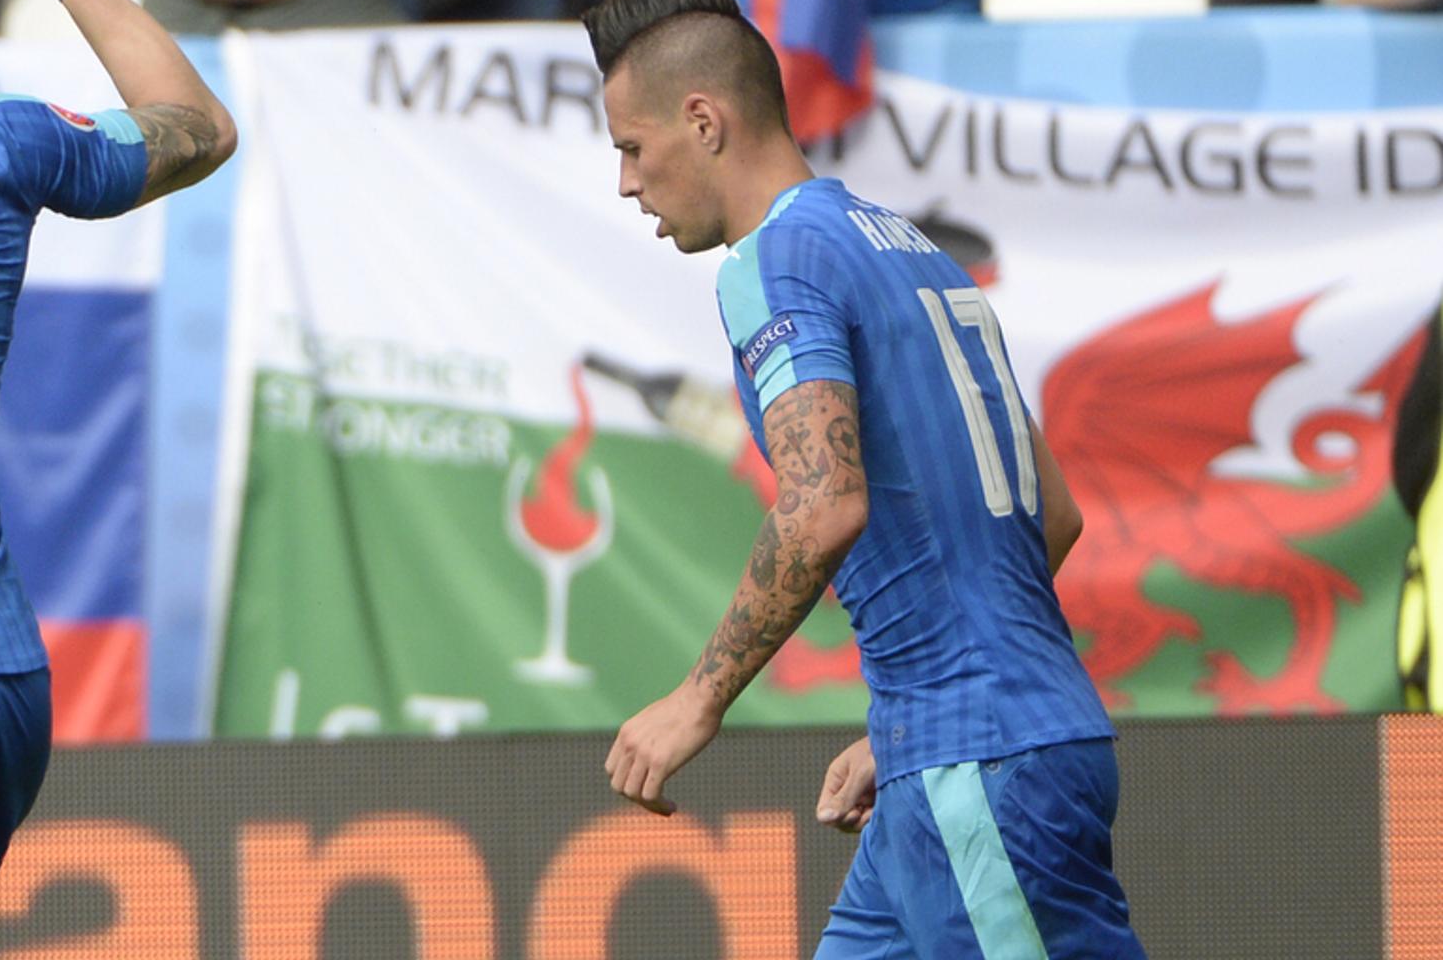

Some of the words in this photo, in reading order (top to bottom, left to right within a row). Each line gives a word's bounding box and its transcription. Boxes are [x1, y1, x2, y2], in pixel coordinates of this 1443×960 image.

[368, 40, 605, 136] MAR
[879, 98, 1315, 199] VILLAGE
[746, 319, 794, 366] RESPECT
[917, 287, 1037, 518] 17
